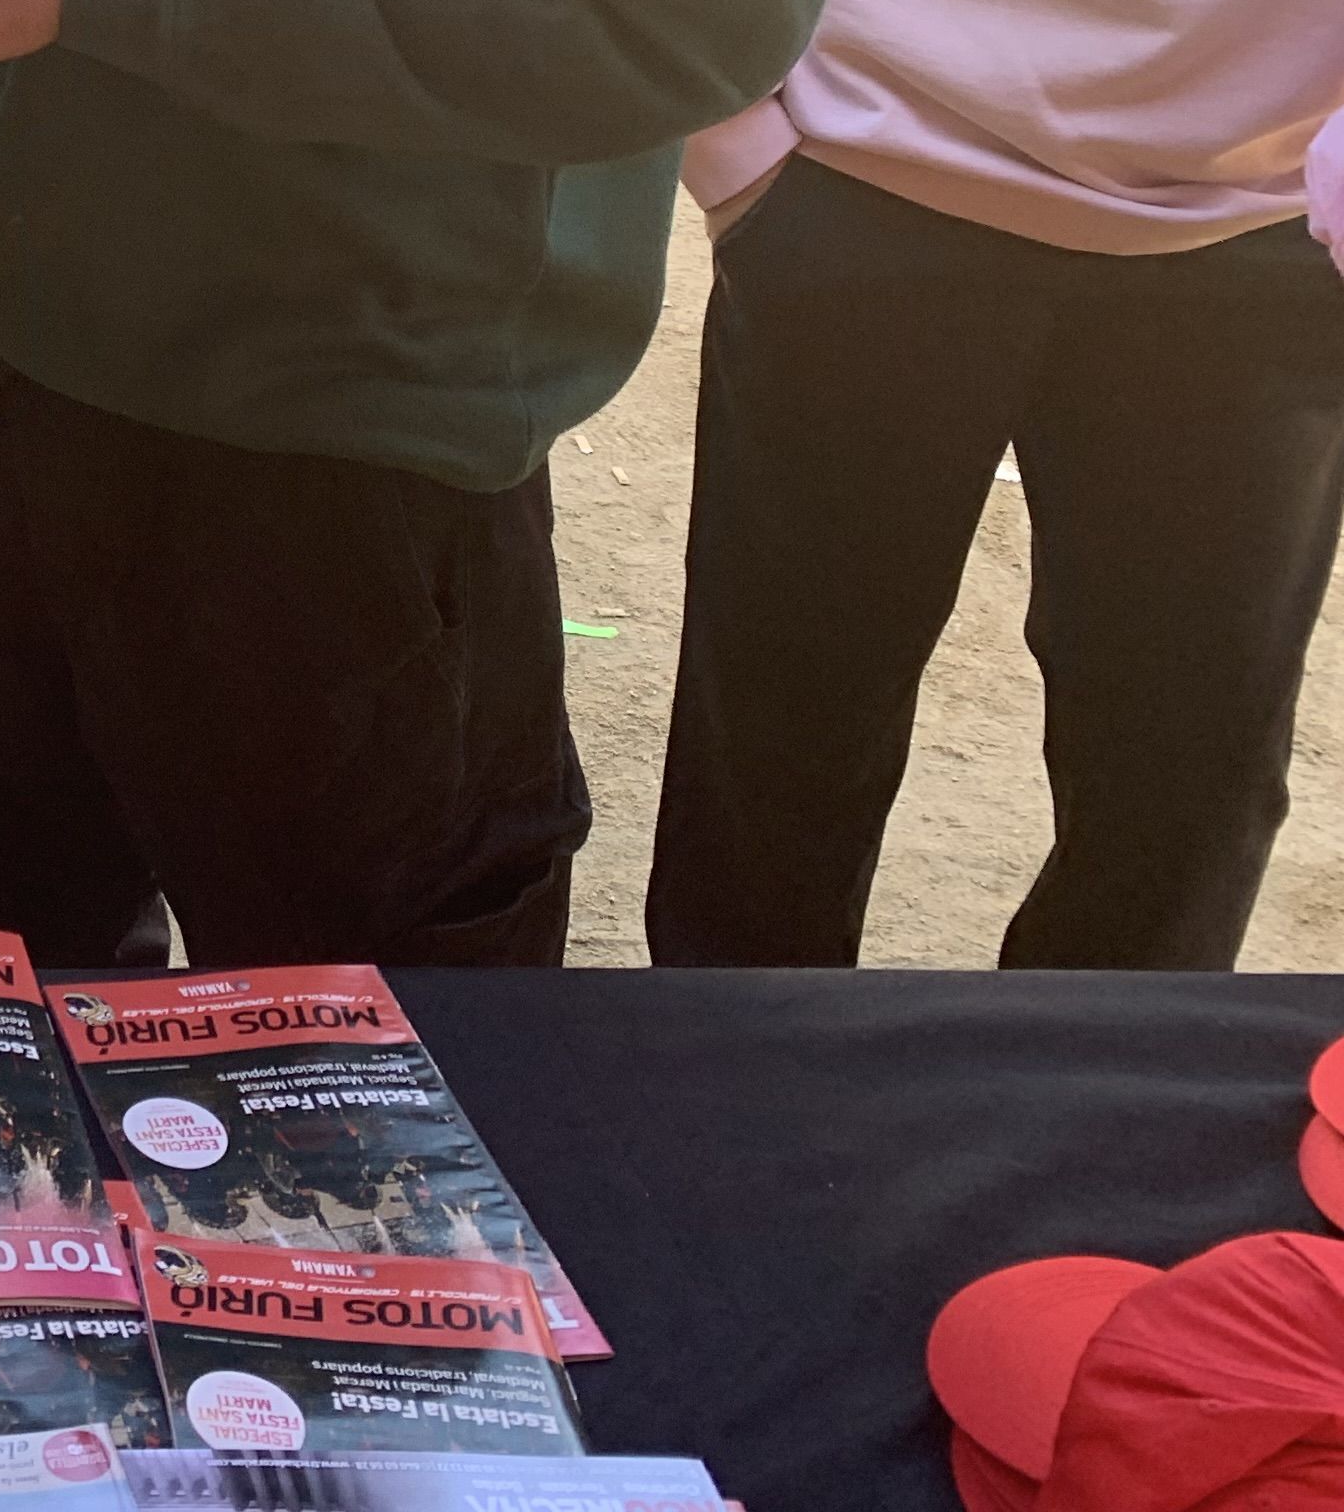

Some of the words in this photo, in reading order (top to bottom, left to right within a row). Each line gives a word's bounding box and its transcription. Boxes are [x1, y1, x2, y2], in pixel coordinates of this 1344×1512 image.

[179, 982, 234, 996] YAMAHA
[230, 1004, 381, 1034] MOTOS
[85, 1016, 218, 1054] FURIÓ
[239, 1094, 311, 1114] Festa!
[315, 1092, 337, 1108] la
[340, 1088, 430, 1109] Esclata
[147, 1114, 194, 1128] MARTÍ
[131, 1129, 172, 1141] SANT
[174, 1126, 221, 1138] FESTA
[148, 1140, 219, 1151] ESPECIAL
[23, 1240, 122, 1276] TOT
[291, 1259, 355, 1276] YAMAHA
[170, 1286, 323, 1321] FURIÓ
[342, 1300, 525, 1335] MOTOS
[216, 1394, 272, 1410] MARTÍ
[330, 1392, 416, 1418] Festa!
[197, 1408, 245, 1423] SANT
[248, 1413, 299, 1430] FESTA
[422, 1402, 452, 1423] la
[454, 1404, 560, 1434] Esclata
[210, 1425, 293, 1447] ESPECIAL
